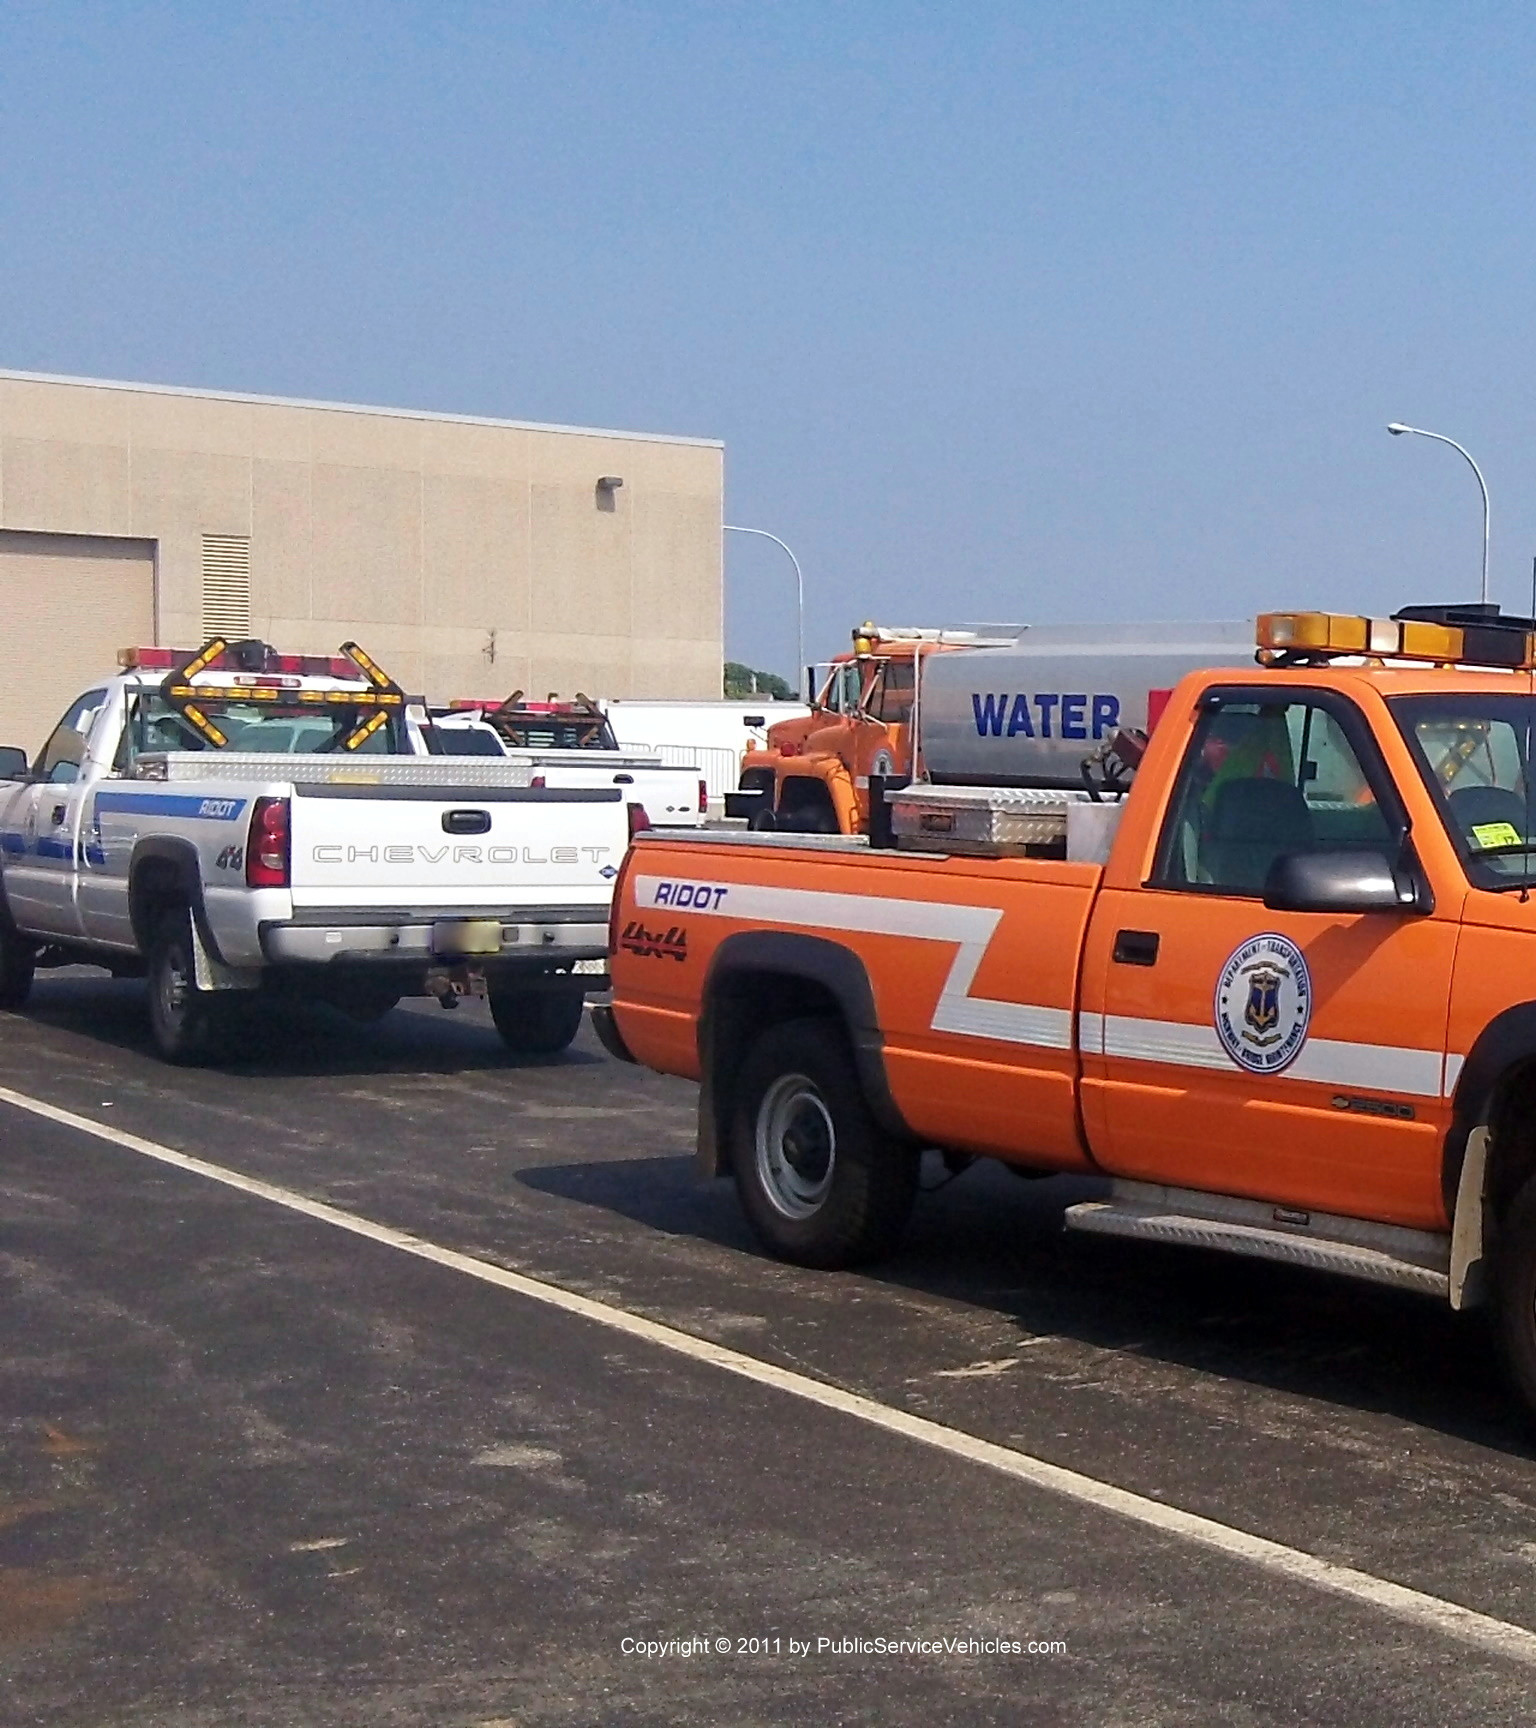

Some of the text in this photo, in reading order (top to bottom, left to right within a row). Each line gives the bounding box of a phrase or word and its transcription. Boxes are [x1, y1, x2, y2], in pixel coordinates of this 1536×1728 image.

[972, 693, 1120, 739] WATER
[199, 800, 236, 817] RIDOT
[313, 845, 610, 864] CHEVROLET
[654, 883, 728, 910] RIDOT
[621, 921, 687, 962] 4x4
